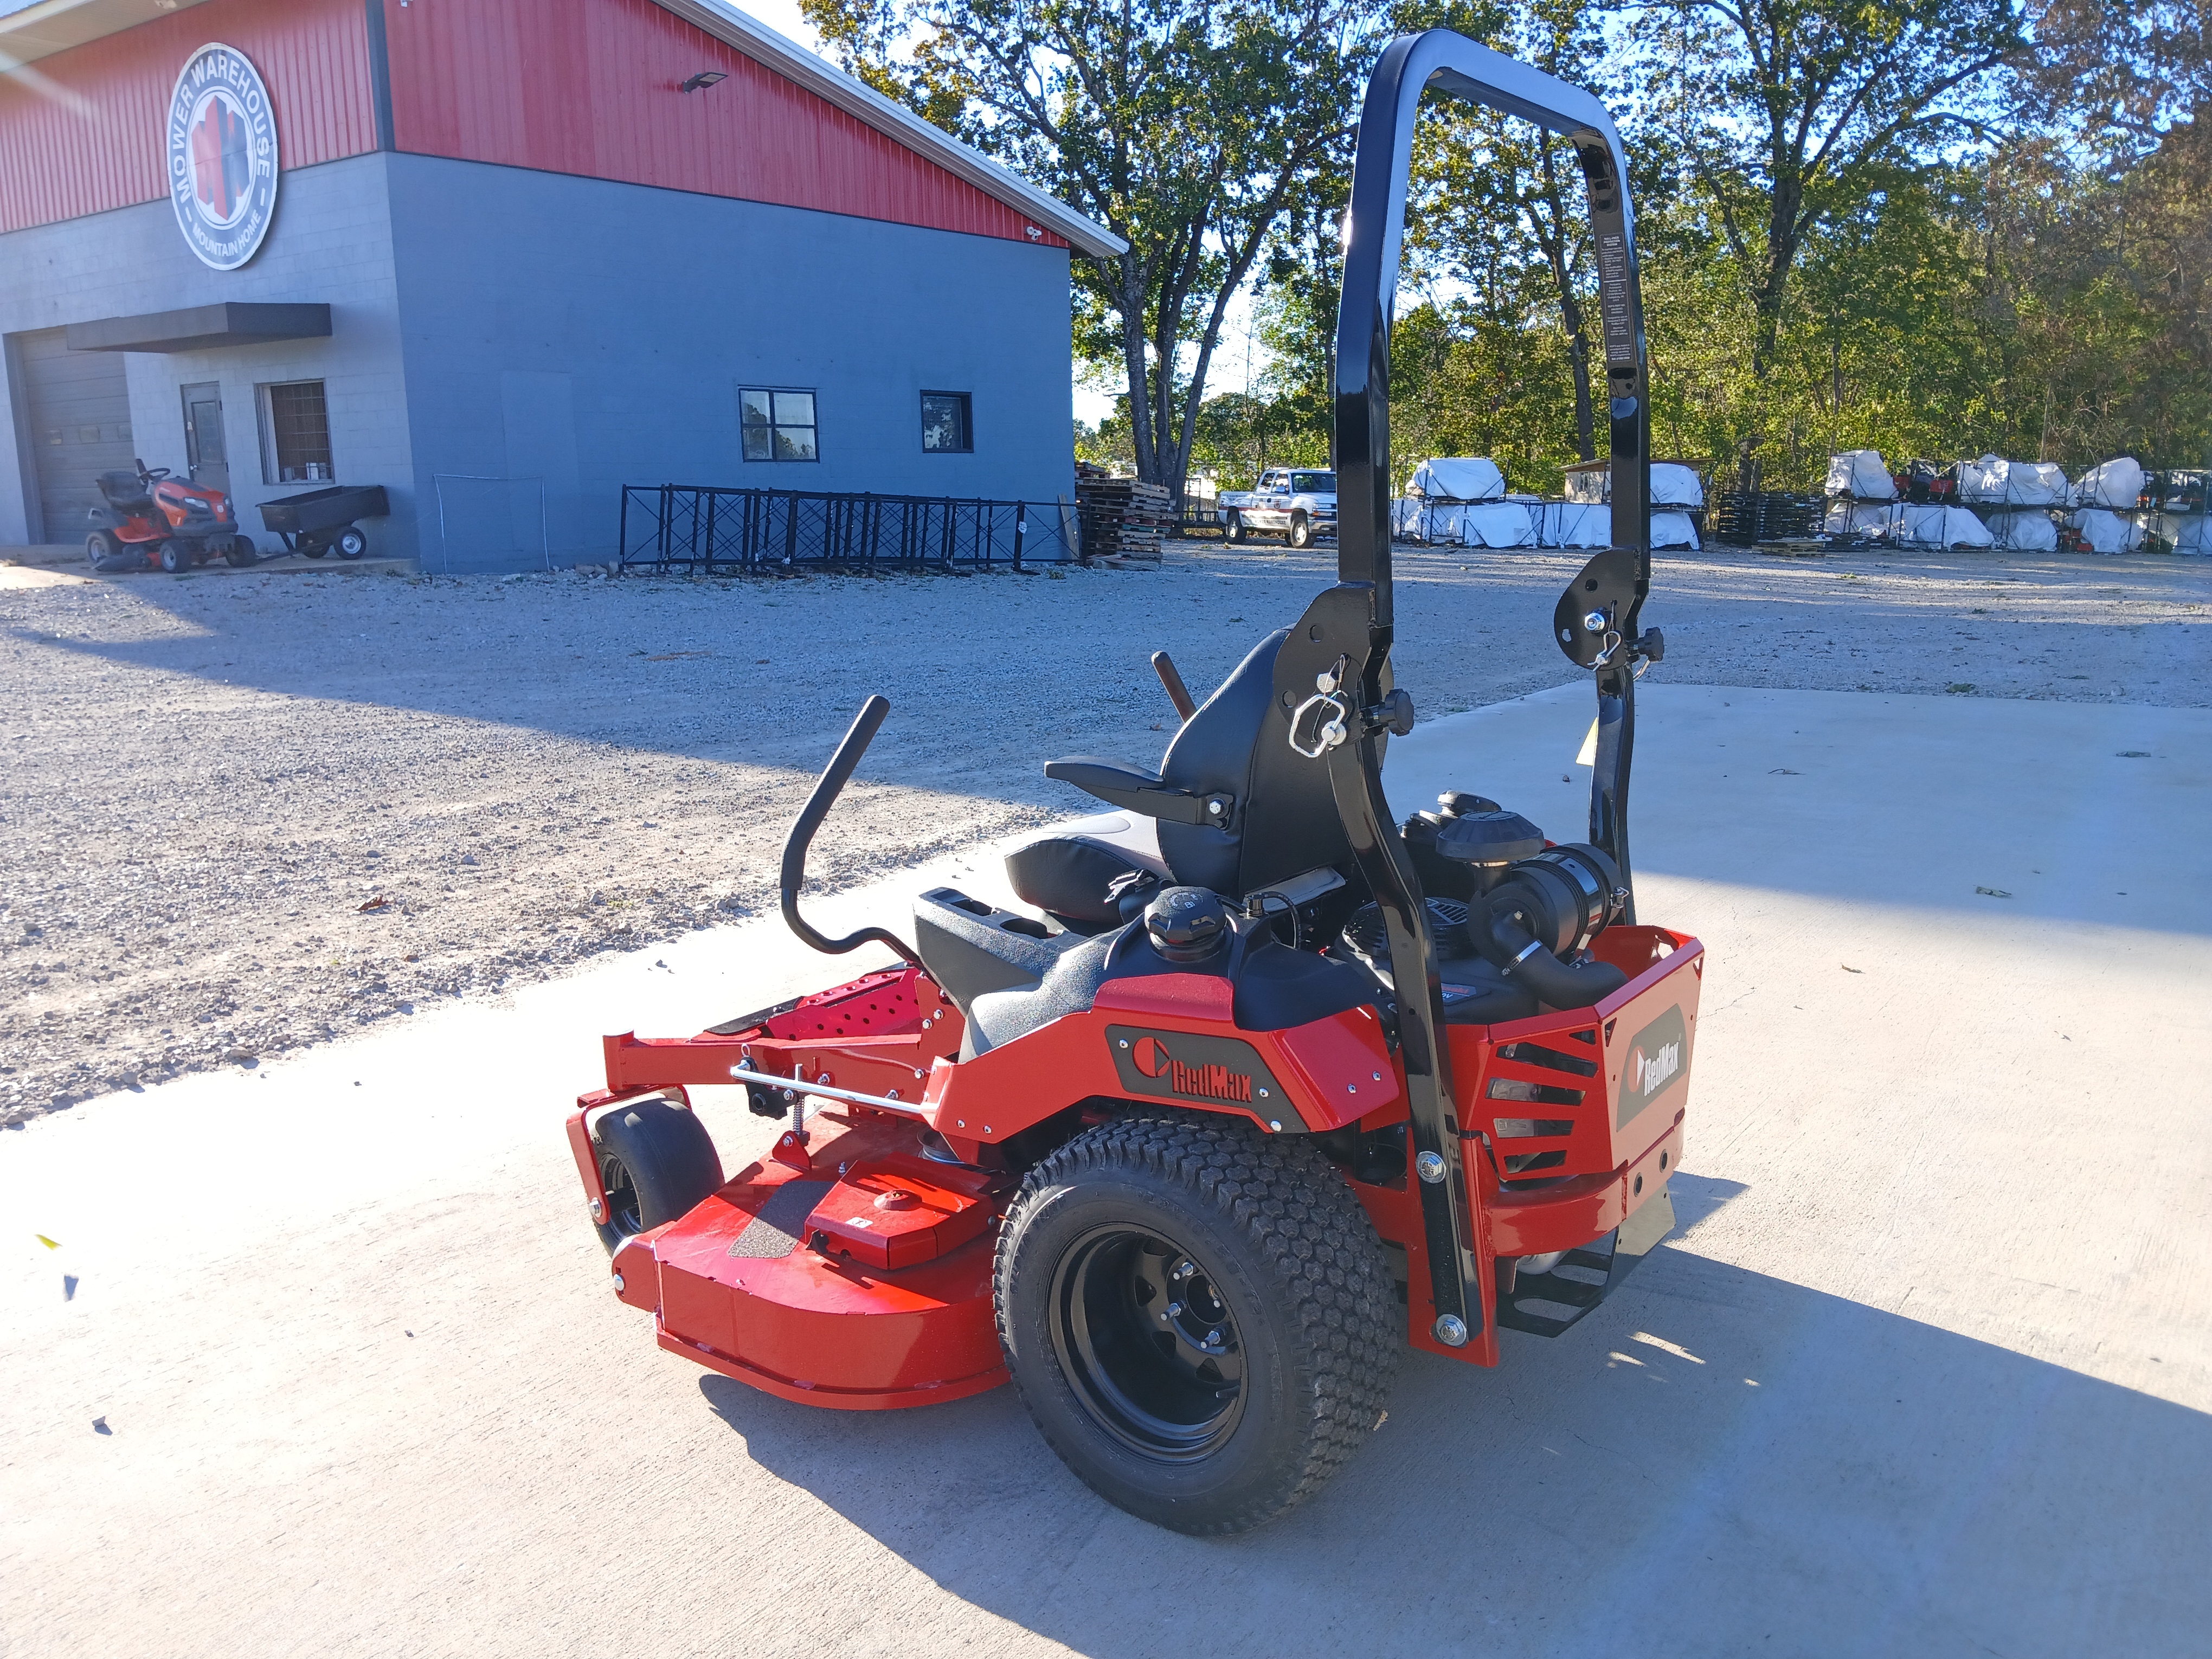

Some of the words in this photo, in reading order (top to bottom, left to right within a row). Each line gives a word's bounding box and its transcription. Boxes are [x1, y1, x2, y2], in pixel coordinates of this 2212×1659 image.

[173, 86, 194, 204] MOWER
[191, 55, 270, 178] WAREHOUSE
[192, 223, 238, 257] MOUNTAIN
[237, 210, 262, 250] HOME
[1171, 1059, 1252, 1103] RedMax
[1644, 1041, 1679, 1096] RedMax
